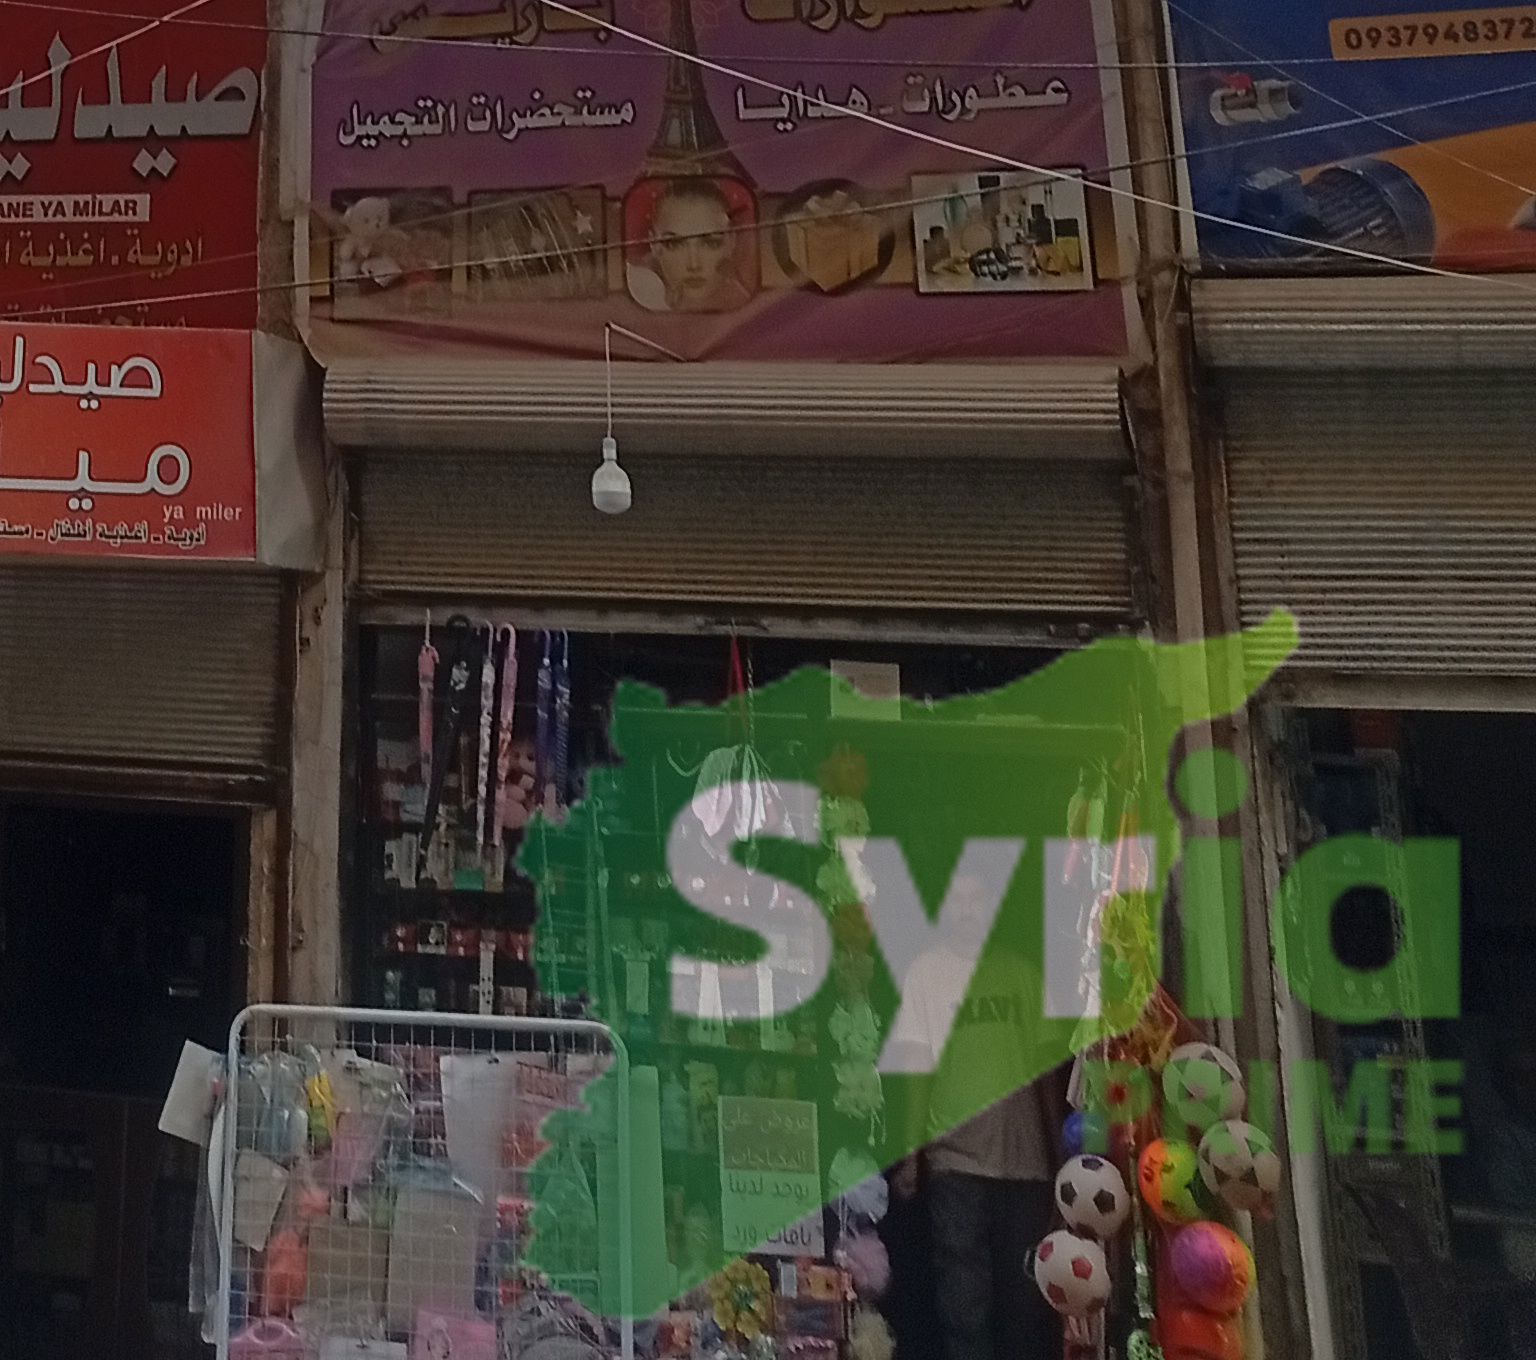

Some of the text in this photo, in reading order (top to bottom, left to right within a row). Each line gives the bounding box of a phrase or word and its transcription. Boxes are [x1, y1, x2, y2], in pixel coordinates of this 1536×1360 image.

[337, 84, 637, 149] مستحضرات التجميل
[734, 70, 1070, 133] عطورات هدايا
[40, 199, 66, 219] YA
[162, 503, 243, 522] ya miler
